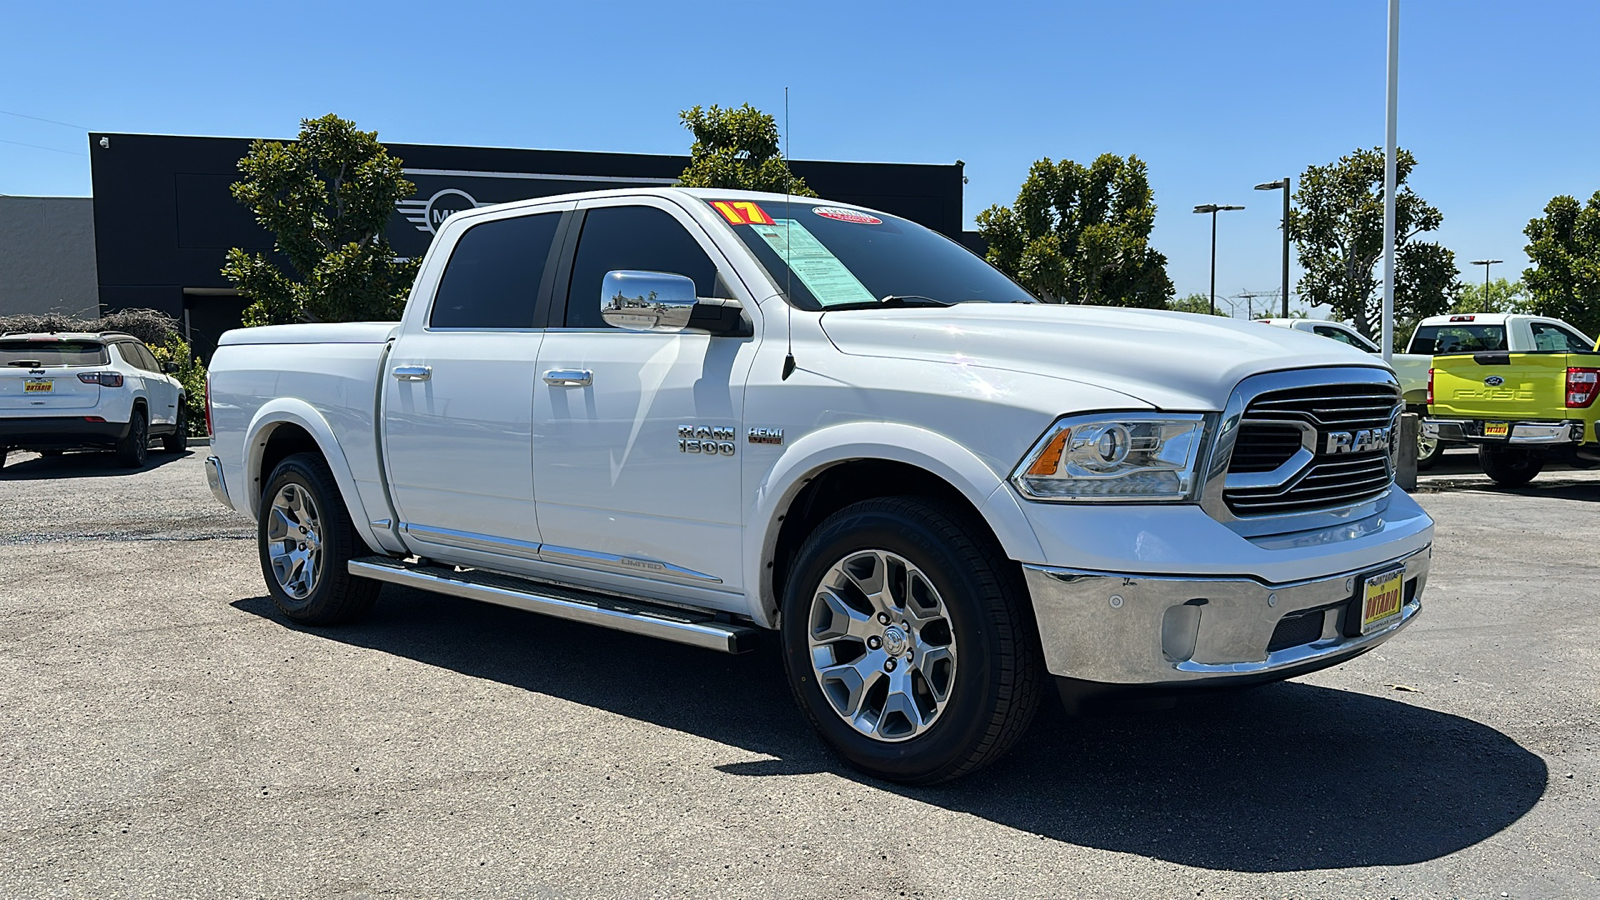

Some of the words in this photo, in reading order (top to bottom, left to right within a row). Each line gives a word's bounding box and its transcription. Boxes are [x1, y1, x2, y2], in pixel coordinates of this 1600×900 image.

[714, 201, 767, 223] 17
[678, 424, 736, 441] RAM
[748, 427, 784, 438] HEMI
[1326, 428, 1390, 454] RAM
[678, 439, 736, 456] 1500
[621, 559, 662, 570] LIMITED
[1365, 589, 1398, 620] ONTARIO
